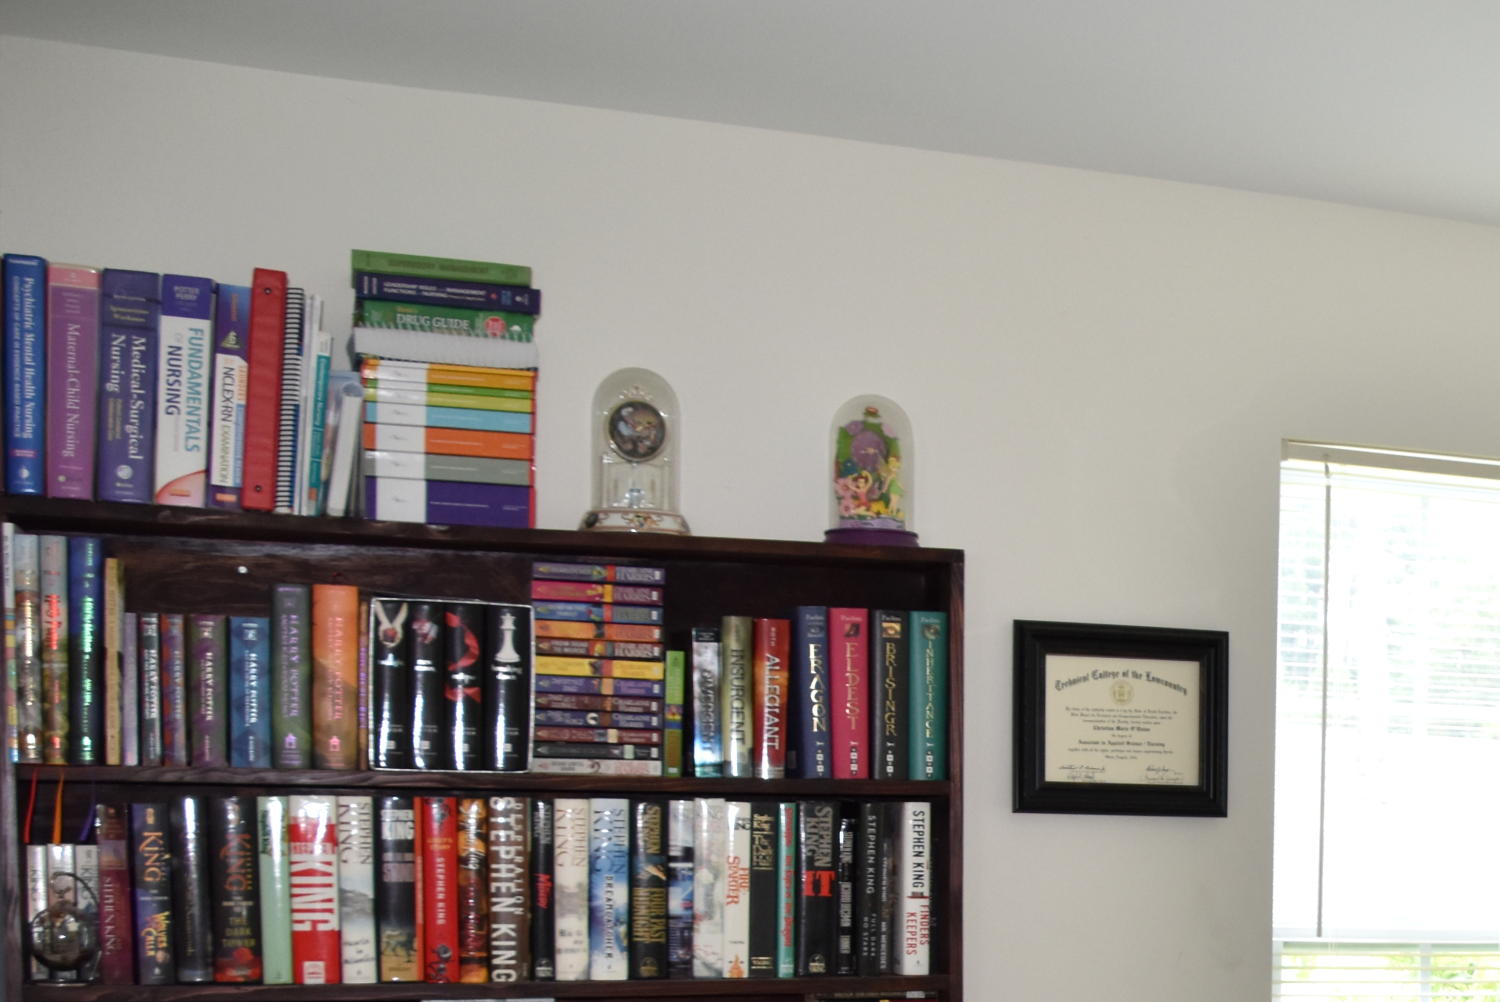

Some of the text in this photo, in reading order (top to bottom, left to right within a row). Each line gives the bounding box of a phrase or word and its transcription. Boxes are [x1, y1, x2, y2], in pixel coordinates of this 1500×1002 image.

[22, 277, 36, 439] Psychiatric Mental Health Nursing
[105, 333, 126, 393] Nursing
[165, 345, 183, 416] NURSING
[184, 327, 205, 452] FUNDAMENTALS
[124, 335, 146, 460] Medical-Surgical
[62, 412, 80, 458] Nursing
[217, 424, 232, 486] EXAMINATION
[289, 614, 299, 717] HARRY POTTER
[334, 617, 344, 720] HARRY POTTER
[729, 648, 746, 744] INSURGENT
[808, 643, 827, 733] ERAGON
[844, 642, 862, 731] ELDEST
[885, 642, 897, 736] BRISINGR
[1091, 668, 1121, 682] College
[1122, 668, 1131, 679] of
[1131, 669, 1144, 681] the
[700, 668, 718, 752] DIVERGENT
[764, 653, 780, 750] ALLEGIANT
[139, 832, 165, 882] KING
[220, 833, 252, 891] KING
[360, 802, 373, 864] STEPHEN
[574, 807, 587, 867] STEPHEN
[612, 808, 626, 874] STEPHEN
[805, 816, 820, 856] KING
[813, 805, 832, 868] STEPHEN
[865, 814, 877, 895] STEPHEN KING
[912, 810, 925, 888] STEPHEN KING
[291, 856, 336, 931] KING
[435, 857, 447, 925] STEPHEN KING
[489, 796, 517, 983] STEPHEN KING
[738, 867, 750, 891] FIRE
[803, 870, 836, 897] IT
[604, 875, 615, 960] DREAMCATCHER
[906, 912, 918, 955] KEEPERS
[919, 904, 929, 946] FINDERS
